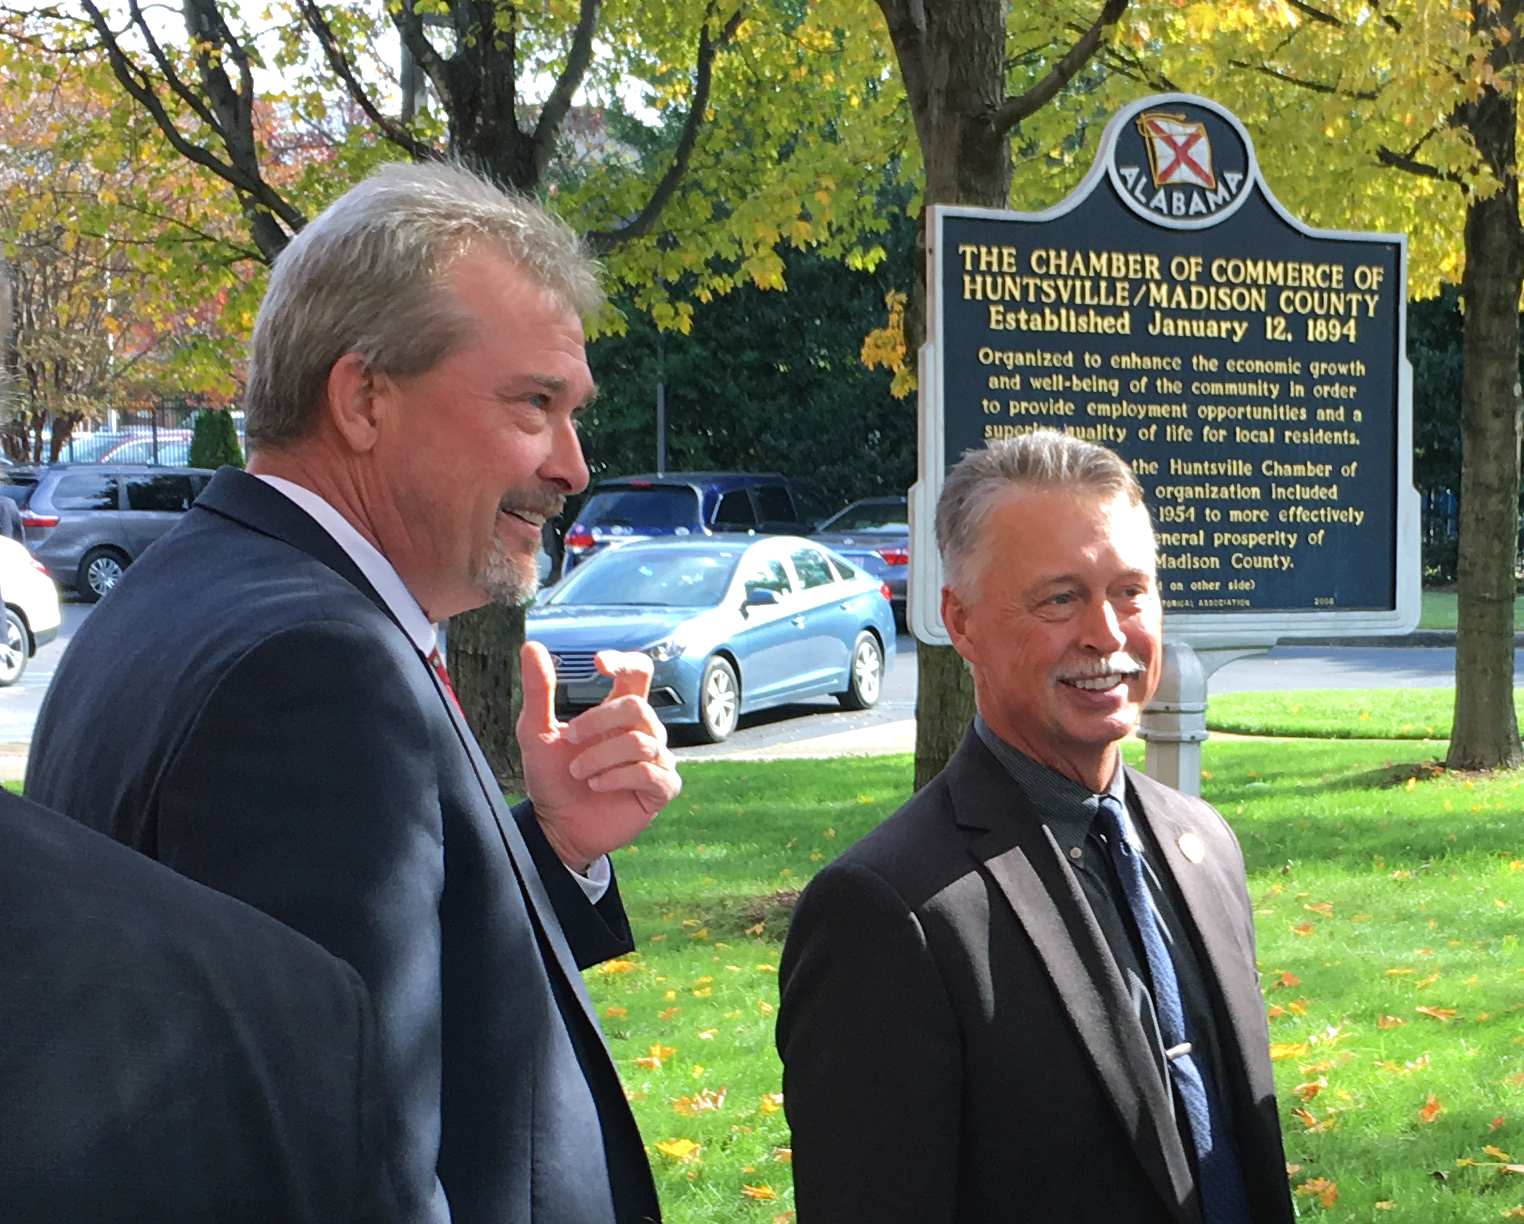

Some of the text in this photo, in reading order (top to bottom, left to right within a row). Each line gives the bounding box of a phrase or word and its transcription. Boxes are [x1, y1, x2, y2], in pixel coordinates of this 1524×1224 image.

[1119, 167, 1243, 216] ALABAMA
[959, 245, 1384, 291] THE CHAMBER OF COMMERCE OF
[962, 274, 1379, 318] HUNTSVILLE/MADISON COUNTY
[989, 304, 1131, 336] Established
[1148, 310, 1249, 343] January
[1307, 317, 1357, 344] 1894
[978, 346, 1366, 380] Organized to enhance the economic growth
[988, 374, 1358, 400] and well-being of the community in order
[981, 398, 1363, 423] to provide employment opportunities and a
[1138, 423, 1158, 441] of
[1166, 424, 1194, 443] life
[1202, 425, 1228, 443] for
[1235, 426, 1275, 444] local
[1284, 427, 1361, 446] residents.
[1131, 458, 1358, 478] the Huntsville Chamber of
[1155, 482, 1339, 503] organization included
[1159, 505, 1365, 526] 1954 to more effectively
[1153, 529, 1325, 549] eneral prosperity of
[1231, 552, 1295, 571] County.
[1169, 582, 1184, 591] on
[1190, 579, 1221, 592] other
[1228, 579, 1256, 592] side)
[1198, 599, 1250, 608] ASSOCIATION
